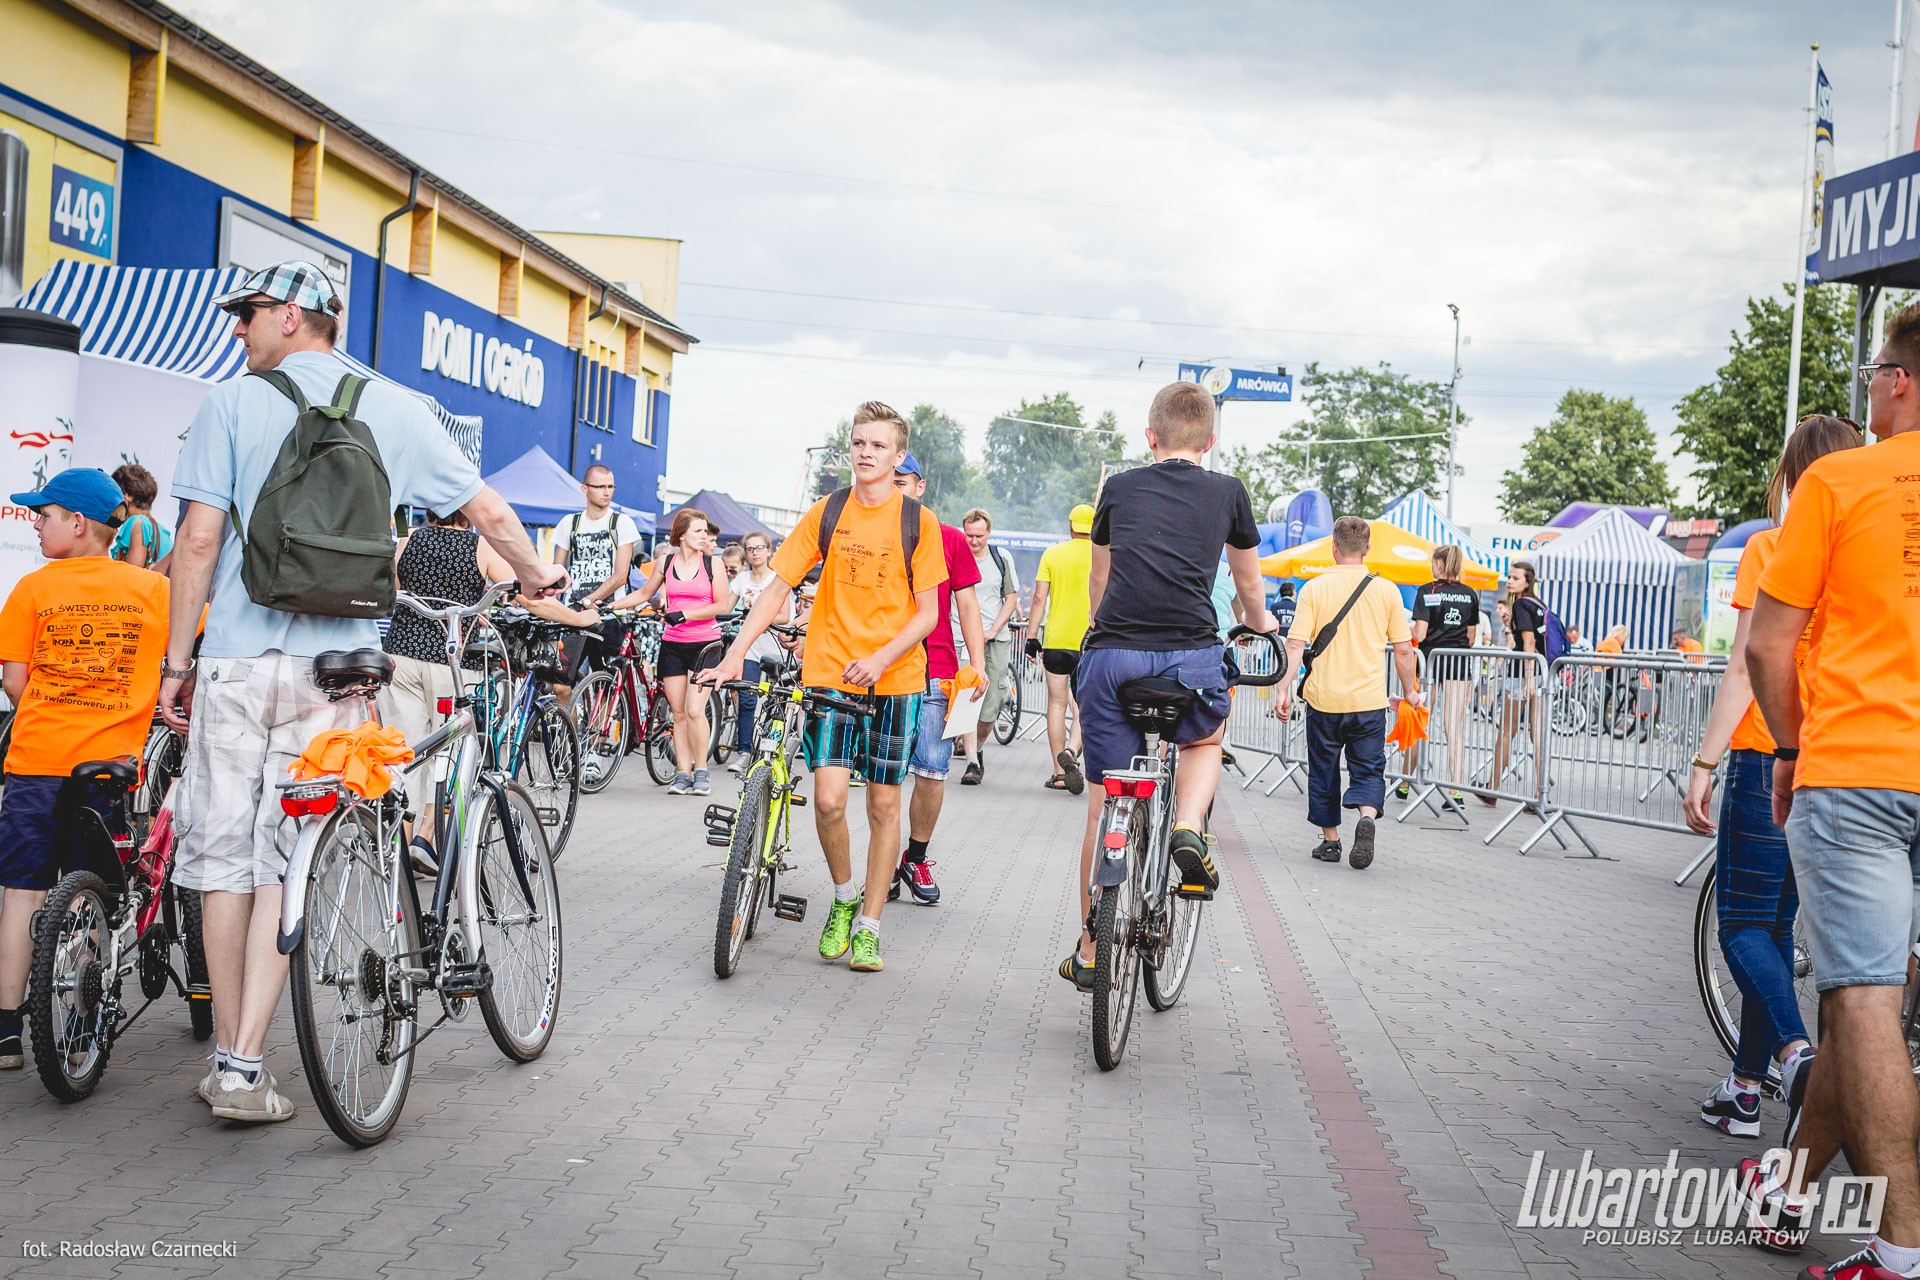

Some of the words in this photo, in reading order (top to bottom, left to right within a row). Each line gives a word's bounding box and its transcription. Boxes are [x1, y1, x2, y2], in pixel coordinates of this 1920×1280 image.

[421, 311, 472, 385] DOM
[472, 332, 484, 388] I
[1236, 376, 1290, 394] MRÓWKA
[1492, 537, 1522, 550] FIN
[58, 604, 100, 613] ŚWIĘTO
[103, 604, 144, 614] ROWERU
